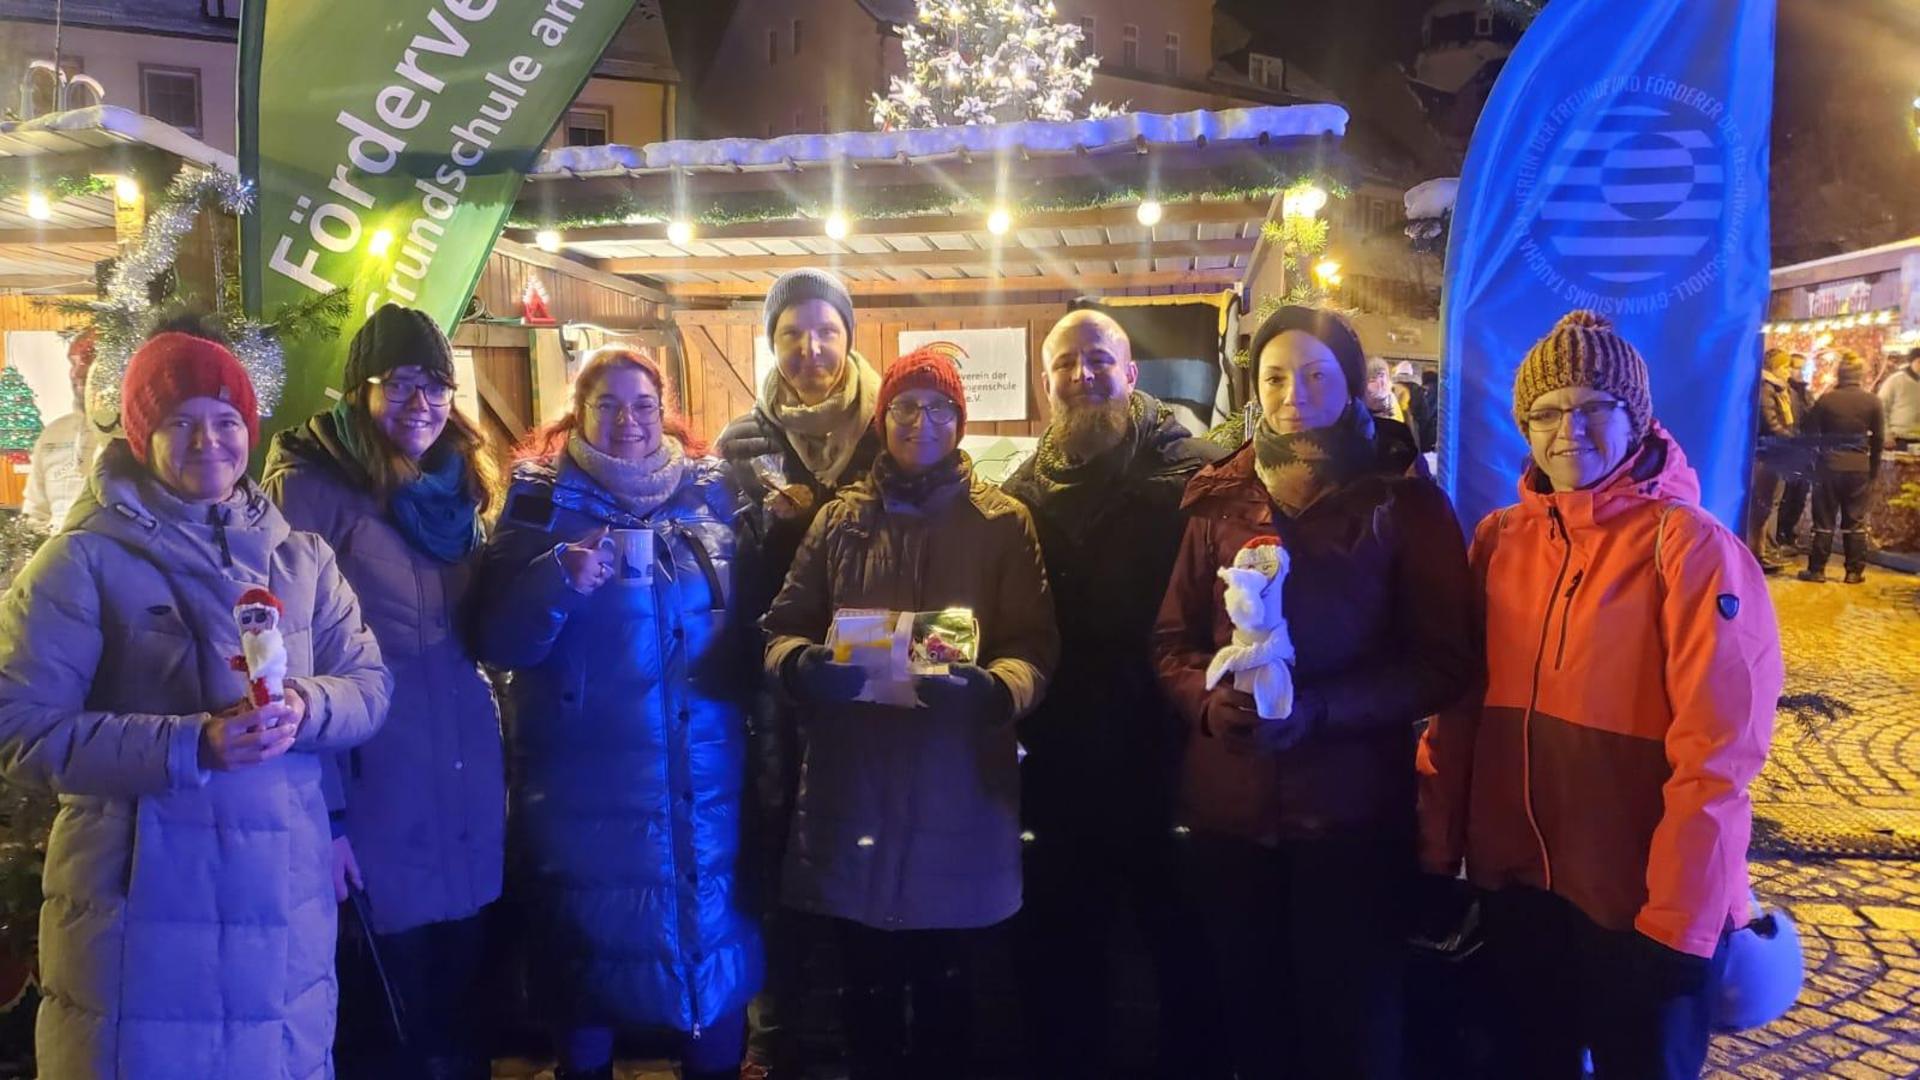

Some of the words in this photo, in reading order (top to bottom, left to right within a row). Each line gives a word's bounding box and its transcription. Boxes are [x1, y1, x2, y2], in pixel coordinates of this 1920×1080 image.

[1610, 73, 1640, 94] UND
[1645, 73, 1724, 120] FÖRDERER
[1529, 121, 1557, 152] DER
[1718, 114, 1743, 144] DES
[1516, 153, 1540, 207] VEREIN
[1519, 238, 1567, 294] TAUCHA
[991, 371, 1007, 380] der
